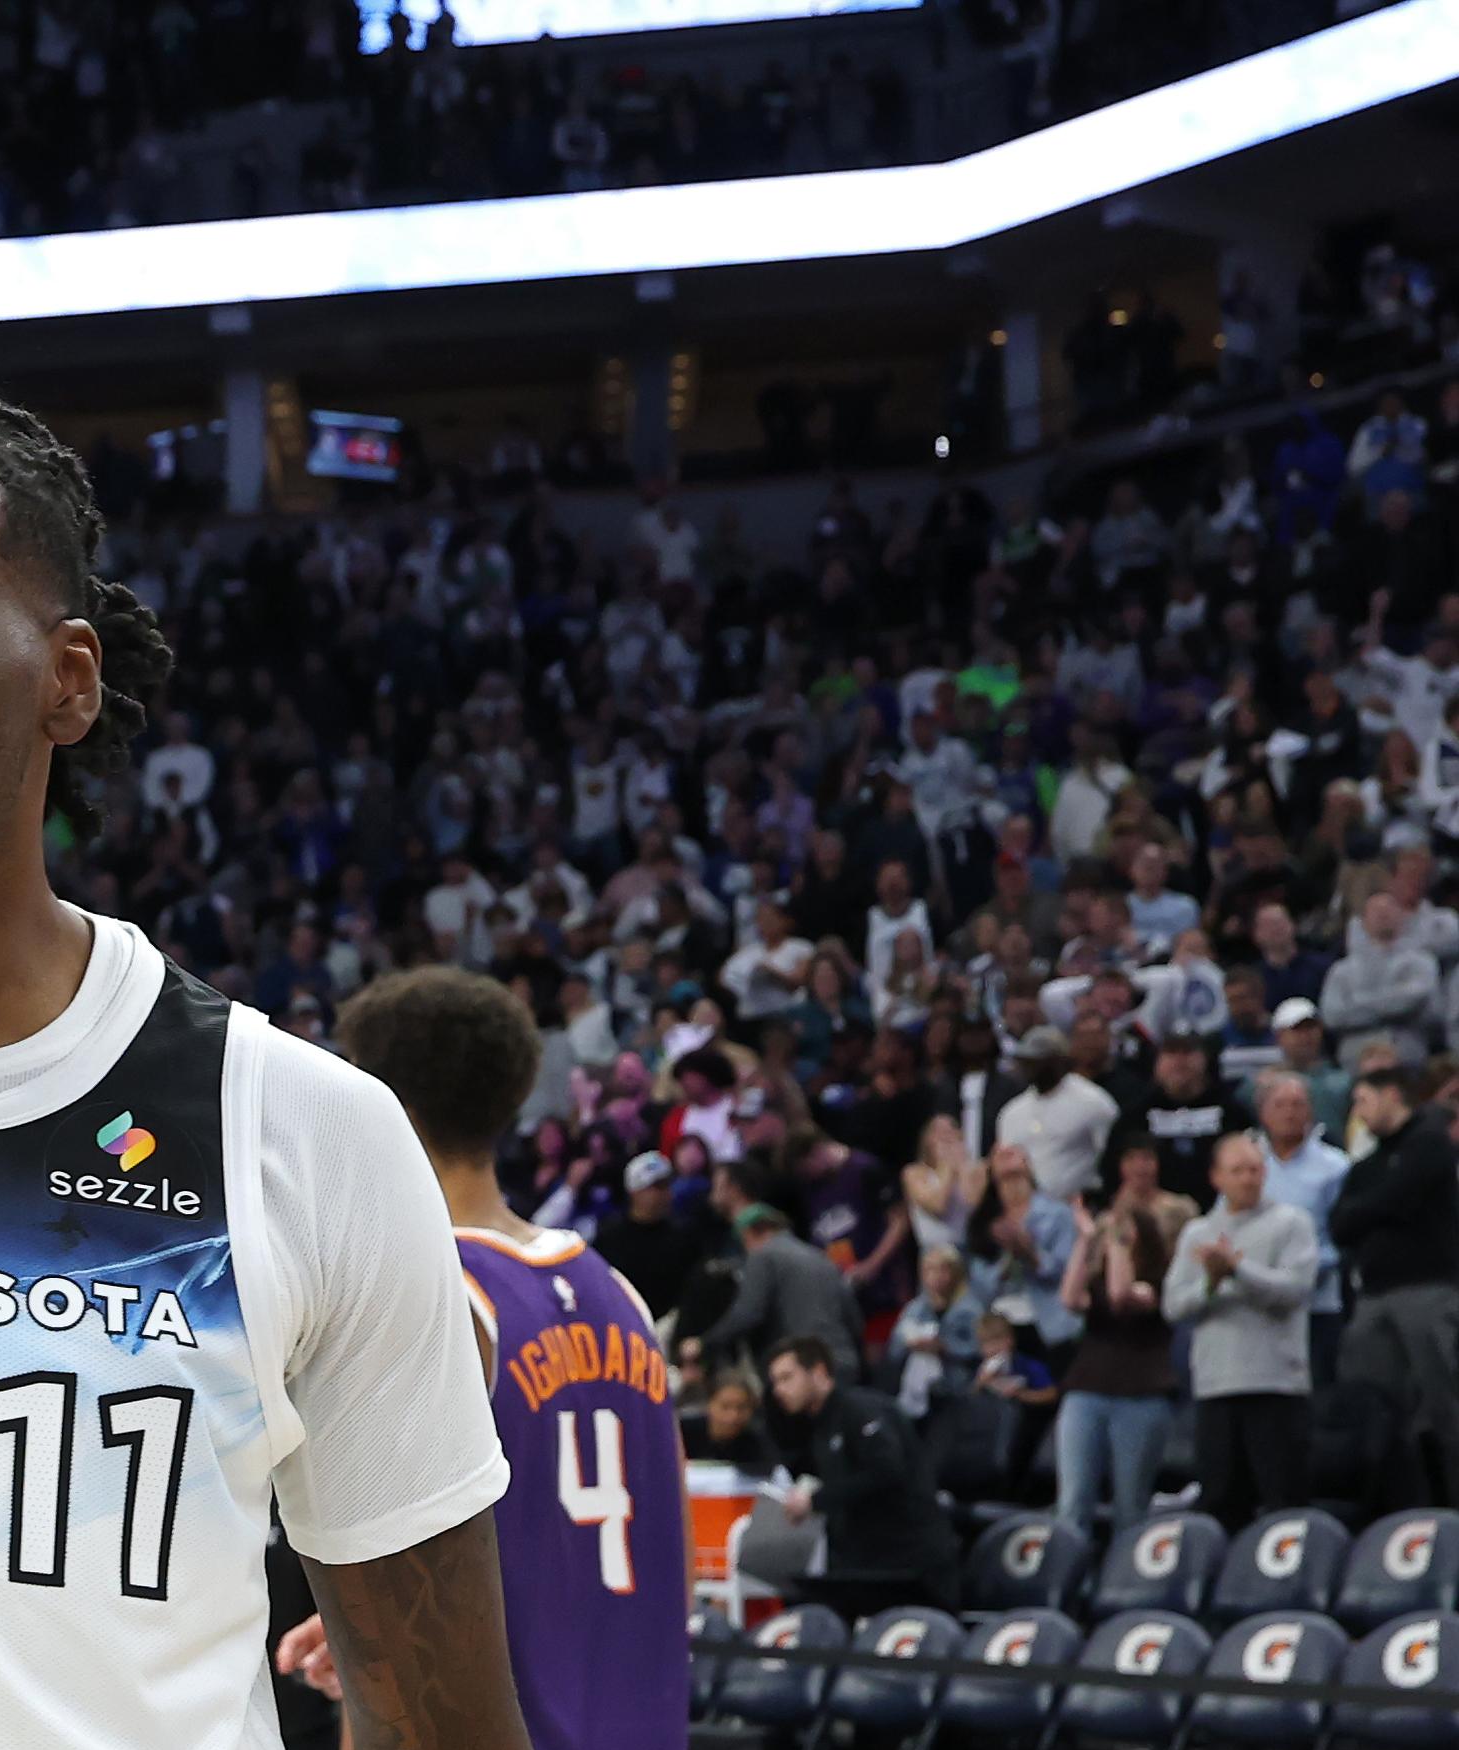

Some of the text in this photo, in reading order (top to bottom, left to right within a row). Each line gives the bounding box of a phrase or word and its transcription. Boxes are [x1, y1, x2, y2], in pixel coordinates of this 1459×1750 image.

[48, 1170, 202, 1216] sezzle
[557, 1408, 636, 1595] 4
[1003, 1524, 1053, 1579] G
[1134, 1520, 1183, 1579] G
[1256, 1519, 1308, 1579] G
[1385, 1519, 1438, 1581] G
[1242, 1622, 1305, 1684] G
[1383, 1619, 1441, 1689] G
